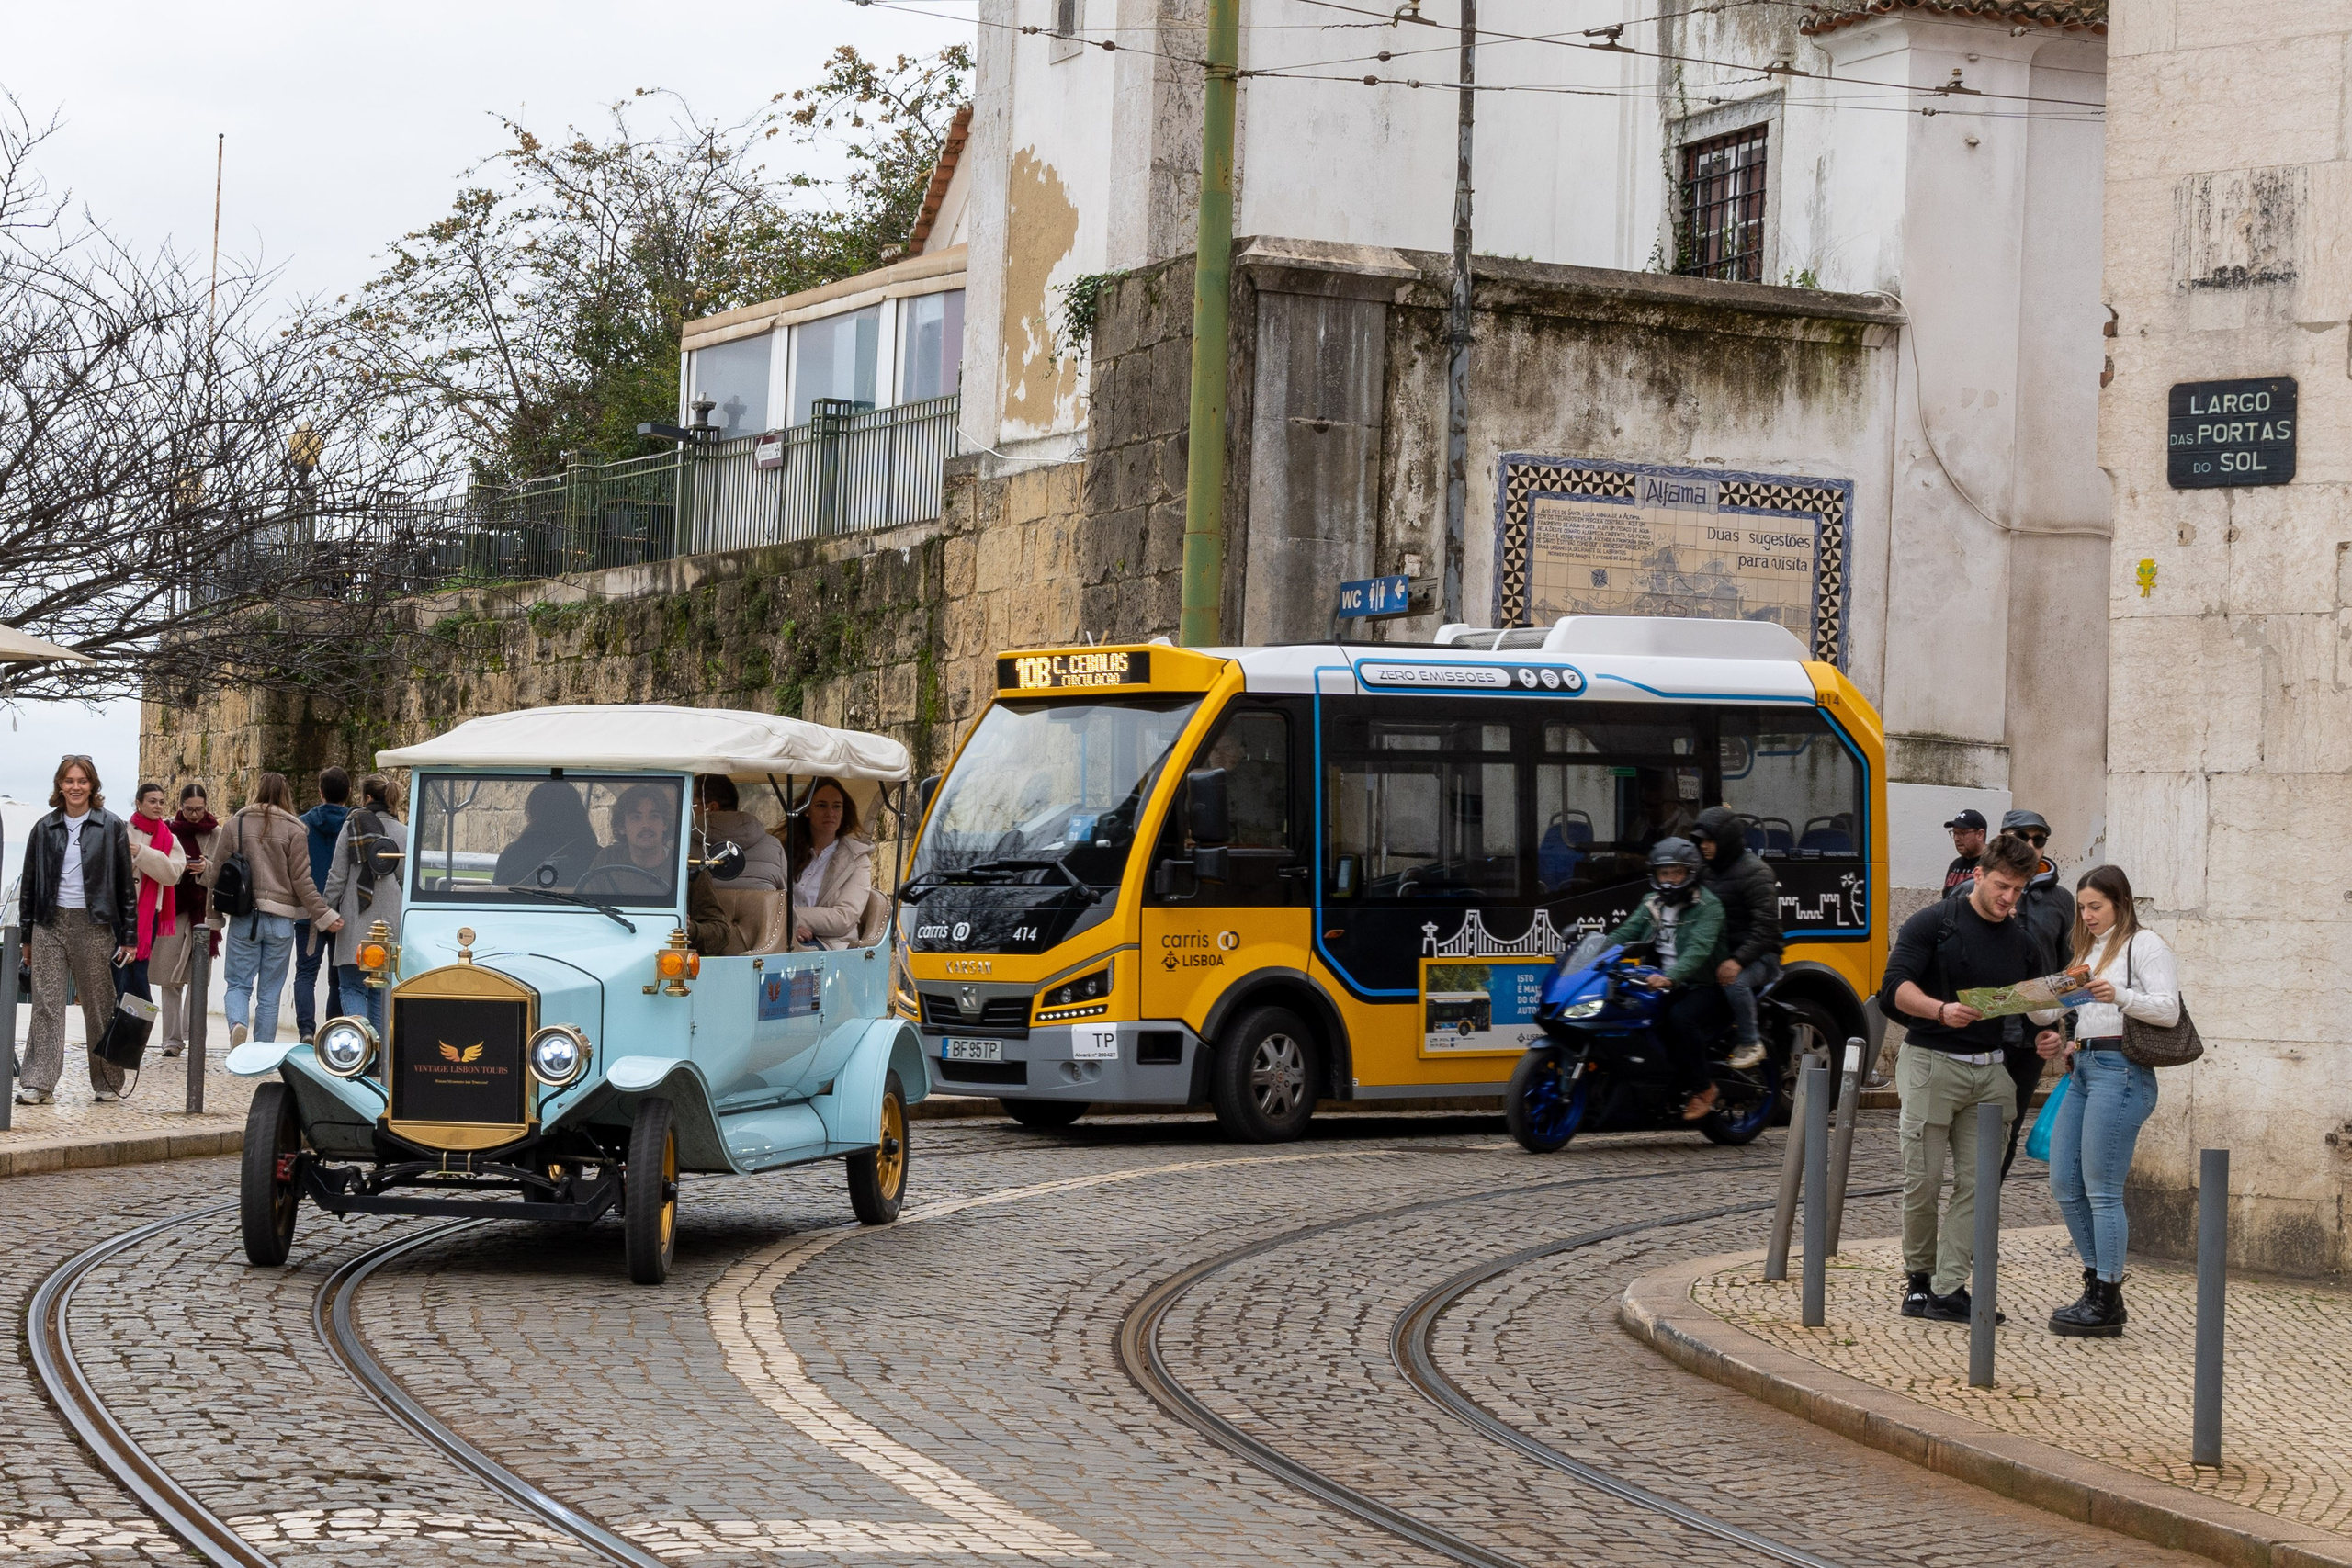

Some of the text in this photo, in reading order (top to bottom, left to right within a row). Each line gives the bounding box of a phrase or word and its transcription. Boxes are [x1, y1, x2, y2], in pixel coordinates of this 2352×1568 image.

[2190, 391, 2270, 415] LARGO
[2169, 420, 2291, 446] DAS PORTAS
[2193, 451, 2267, 474] DO SOL
[1645, 479, 1706, 507] Alfama
[1707, 526, 1811, 551] Duas sugestões
[1737, 554, 1808, 572] para visita
[1341, 589, 1362, 610] WC
[1015, 656, 1052, 689] 10B
[1069, 652, 1129, 674] CEBOLAS
[1376, 670, 1497, 682] ZERO EMISSÕES
[1817, 693, 1840, 706] 414
[917, 920, 1038, 942] carris 414
[1161, 929, 1209, 948] carris
[945, 960, 992, 975] KARSAN
[1182, 954, 1225, 967] LISBOA
[1517, 974, 1534, 983] ISTO
[1517, 996, 1528, 1004] DO
[1517, 1006, 1540, 1014] AUTO
[1092, 1033, 1114, 1048] TP
[413, 1064, 508, 1075] VINTAGE LISBON TOURS
